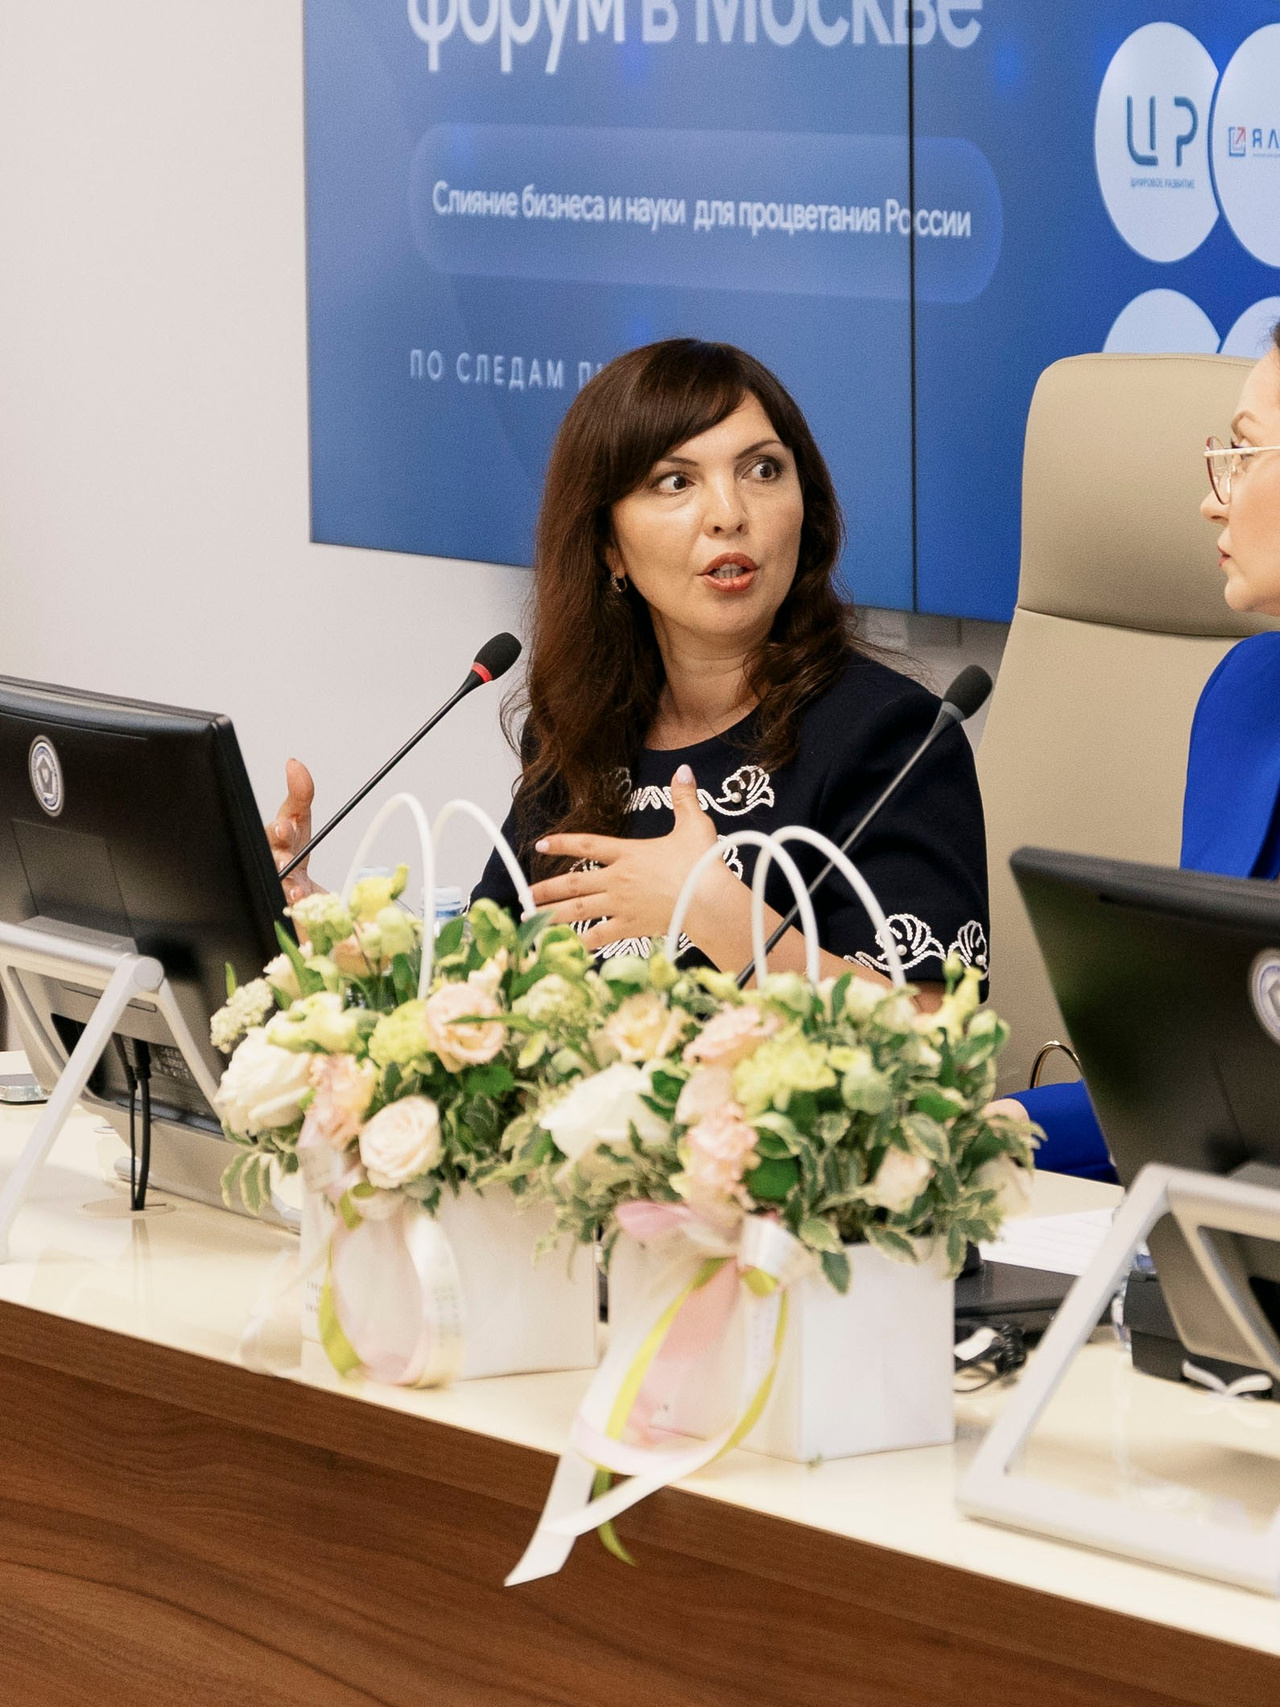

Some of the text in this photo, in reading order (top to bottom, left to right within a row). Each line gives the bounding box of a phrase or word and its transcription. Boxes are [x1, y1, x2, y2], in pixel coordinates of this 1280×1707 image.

[432, 180, 972, 237] Слияние бизнеса и науки для процветания России
[410, 350, 443, 381] ПО
[456, 352, 564, 391] СЛЕДАМ
